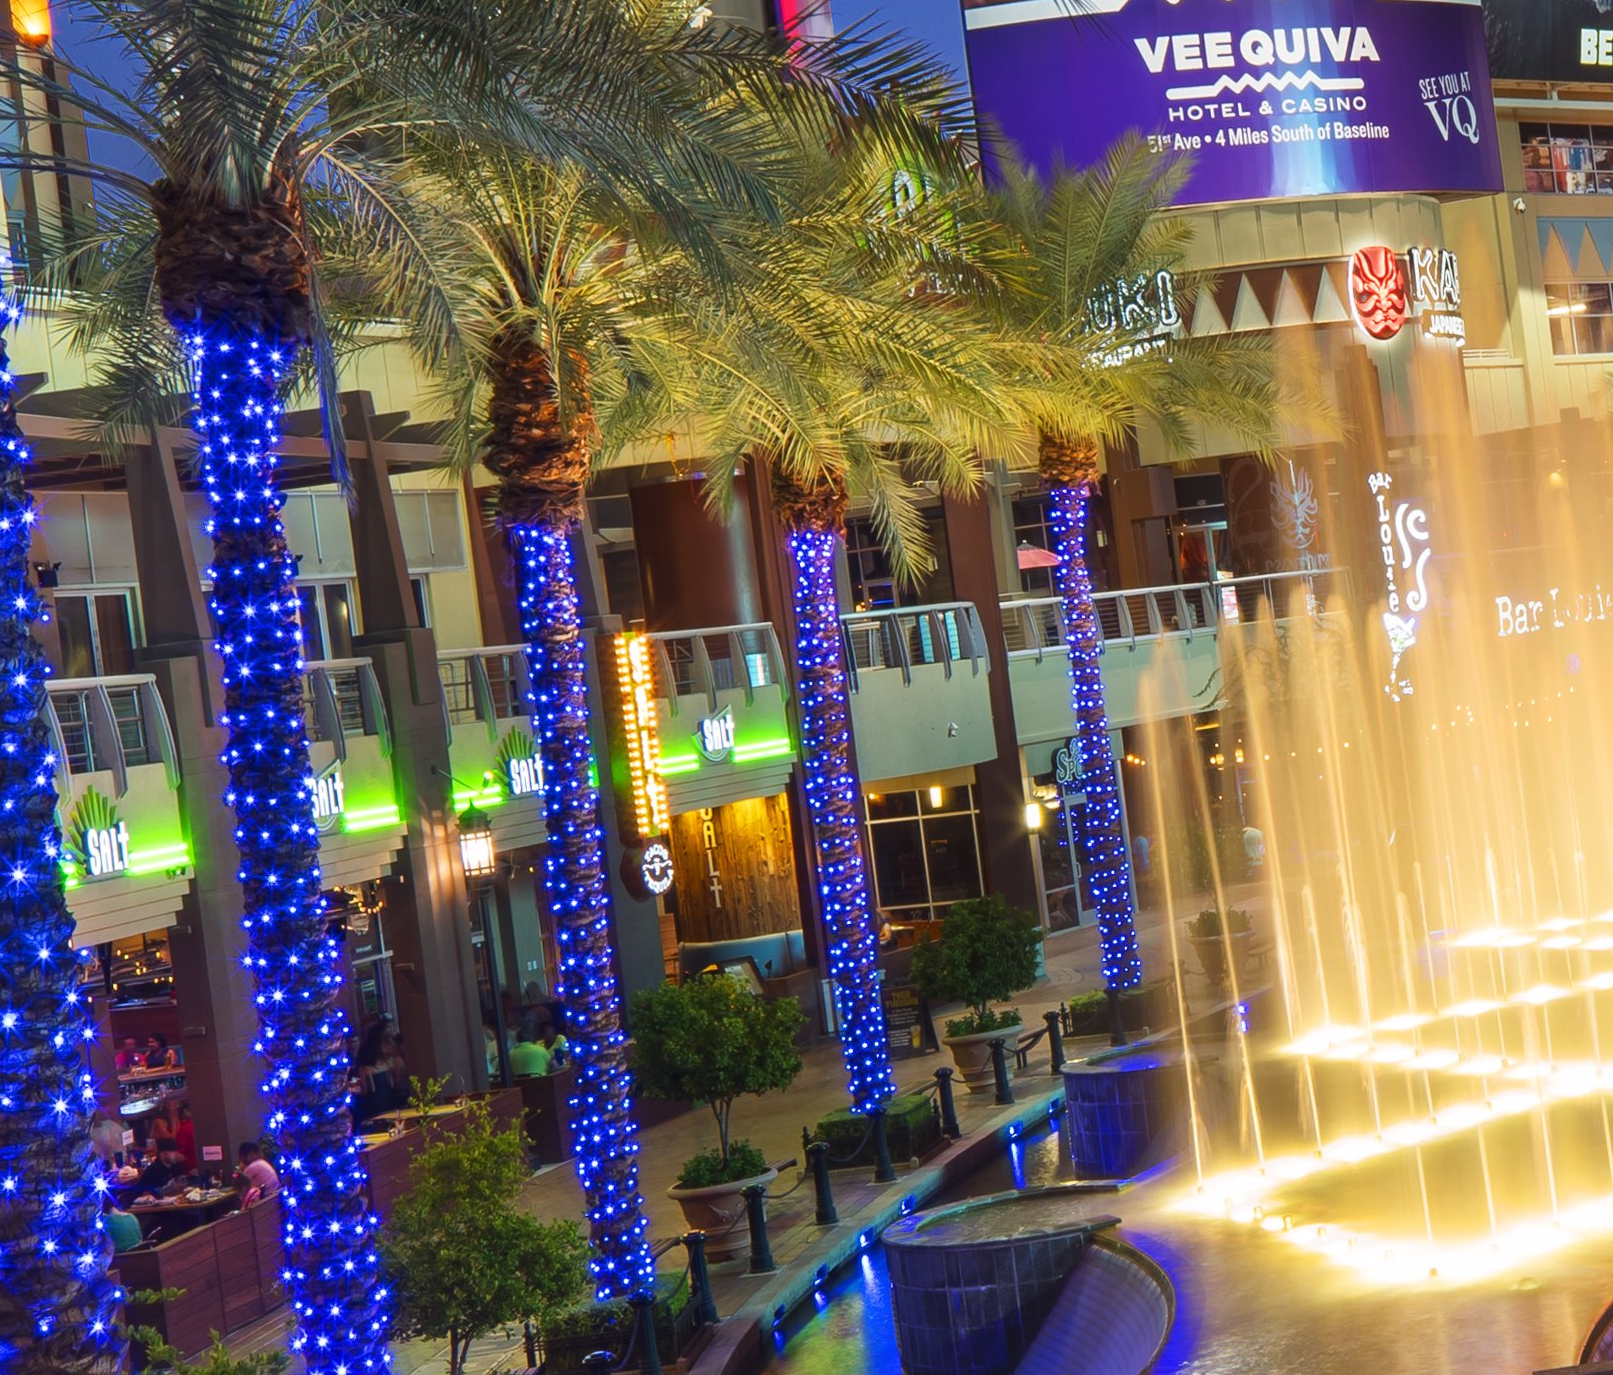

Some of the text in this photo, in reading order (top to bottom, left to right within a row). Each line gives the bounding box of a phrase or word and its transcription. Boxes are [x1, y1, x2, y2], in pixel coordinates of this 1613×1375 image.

[1134, 26, 1381, 74] VEE QUIVA
[1418, 72, 1471, 101] SEE YOU AT
[1168, 96, 1368, 122] HOTEL & CASINO
[1424, 97, 1481, 145] VQ
[1173, 132, 1202, 153] Ave
[1215, 131, 1226, 148] 4
[1228, 128, 1268, 146] Miles
[1271, 125, 1314, 143] South
[1317, 123, 1332, 141] of
[1334, 120, 1390, 141] Baseline
[1368, 472, 1392, 494] Bar
[1495, 596, 1544, 637] Bar
